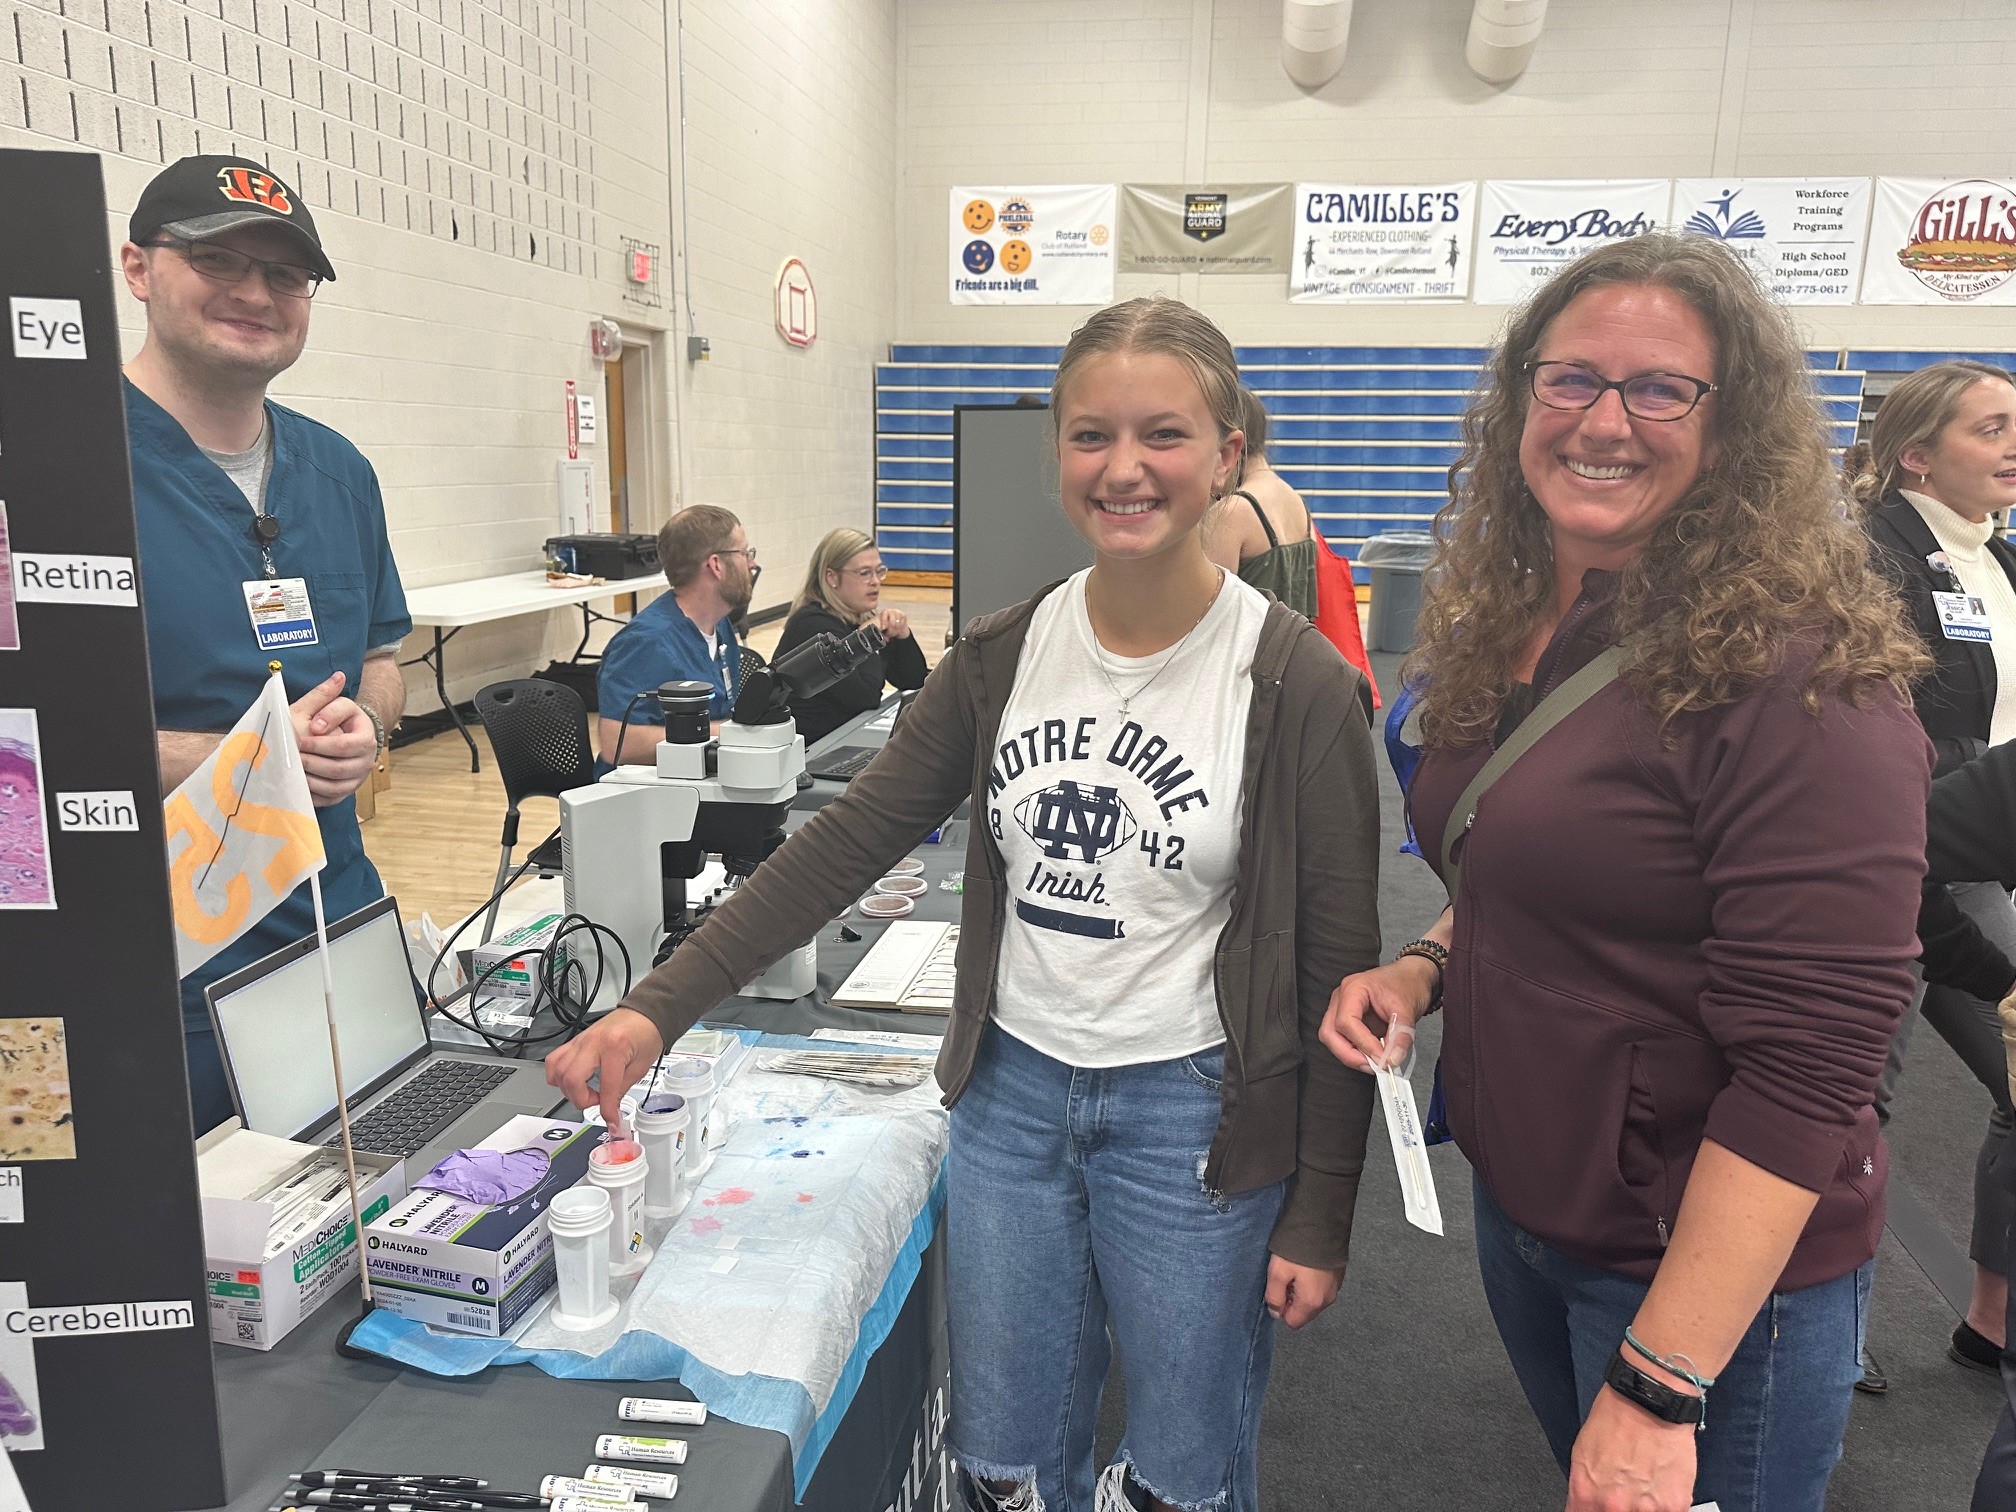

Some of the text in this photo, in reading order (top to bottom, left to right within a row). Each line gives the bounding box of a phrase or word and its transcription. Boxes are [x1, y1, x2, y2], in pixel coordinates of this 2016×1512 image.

[1796, 190, 1849, 198] Workforce
[1189, 203, 1222, 212] ARMY
[1306, 192, 1460, 223] CAMILLE'S
[1798, 206, 1843, 216] Training
[1187, 218, 1223, 227] GUARD
[1793, 222, 1843, 232] Programs
[1055, 231, 1087, 241] Rotary
[1493, 246, 1530, 256] Physical
[1531, 246, 1566, 257] Therapy
[1782, 252, 1846, 261] High School
[1775, 268, 1849, 278] Diploma/GED
[956, 279, 987, 292] Friends
[988, 282, 1002, 291] are
[1003, 282, 1009, 291] a
[1010, 279, 1022, 292] big
[1303, 282, 1341, 295] VINTAGE
[1349, 282, 1415, 294] CONSIGNMENT
[1424, 282, 1456, 294] THRIFT
[1924, 274, 2002, 293] DELICATESSEN
[18, 311, 81, 350] Eye
[21, 560, 135, 591] Retina
[261, 628, 313, 644] LABORATORY
[1946, 628, 1990, 639] LABORATORY
[988, 717, 1209, 822] NOTRE DAME
[63, 798, 134, 827] Skin
[1140, 829, 1185, 871] 42
[403, 1190, 443, 1218] HALYAR
[419, 1203, 460, 1233] LAVENDER
[429, 1212, 460, 1235] NITRILE
[382, 1240, 428, 1256] HALYARD
[512, 1226, 539, 1256] HALYARD
[298, 1230, 348, 1270] Cotton-Tipped
[298, 1241, 345, 1282] Applicators
[503, 1248, 536, 1284] LAVENDER
[299, 1285, 305, 1294] 2
[329, 1256, 342, 1271] 100
[367, 1257, 461, 1283] LAVENDER NITRILE
[412, 1276, 430, 1285] EXAM
[431, 1279, 456, 1290] GLOVES
[475, 1281, 486, 1292] M
[6, 1303, 191, 1334] Cerebellum
[470, 1306, 491, 1316] 52818
[642, 1472, 667, 1480] Resources
[597, 1485, 622, 1493] Resources
